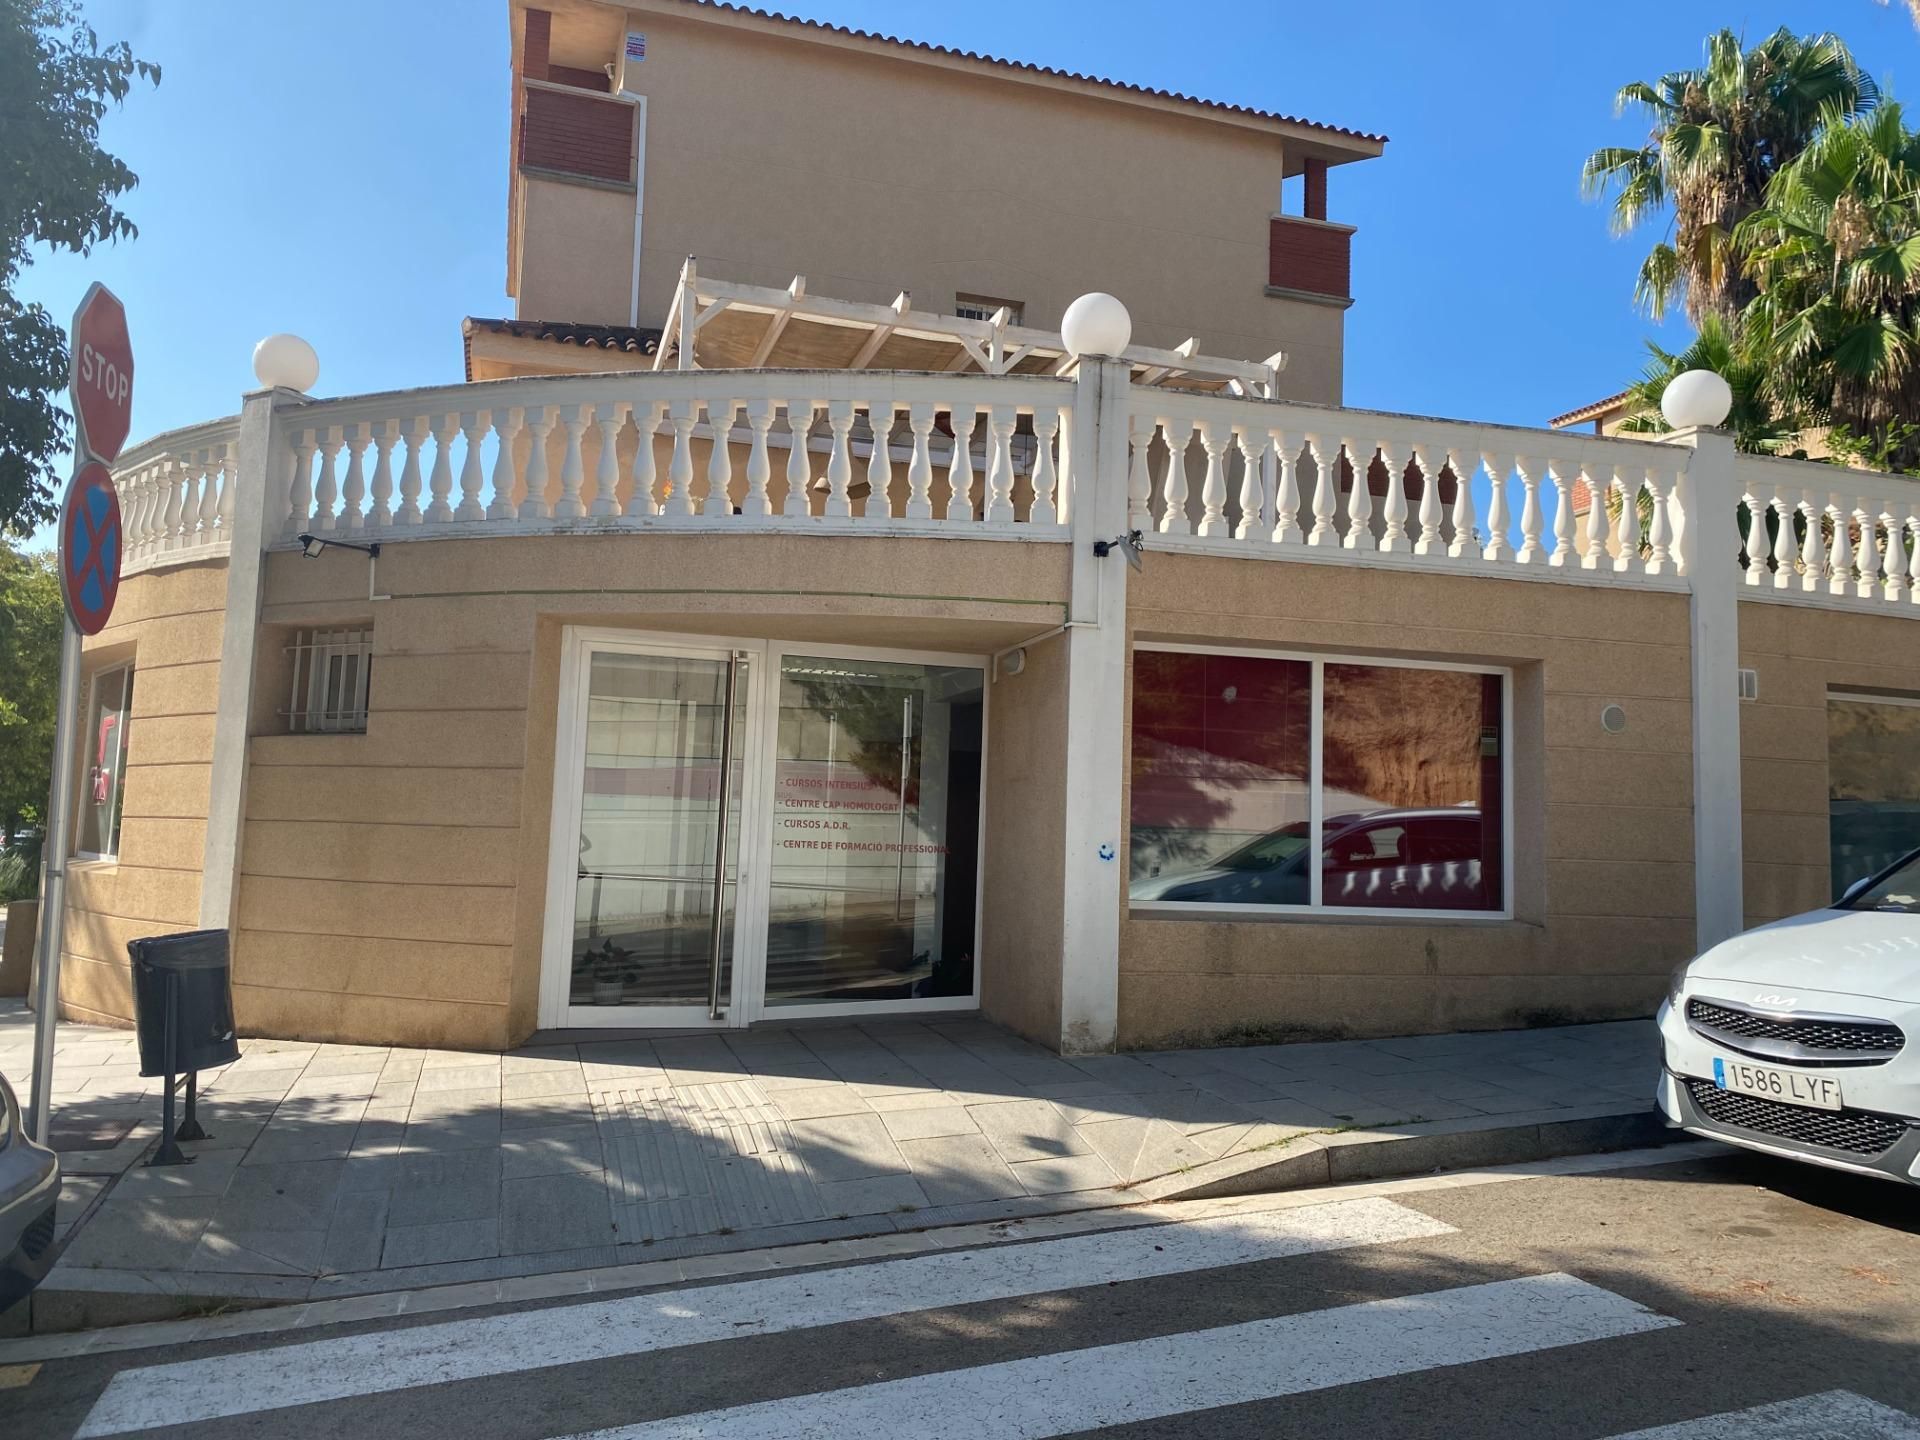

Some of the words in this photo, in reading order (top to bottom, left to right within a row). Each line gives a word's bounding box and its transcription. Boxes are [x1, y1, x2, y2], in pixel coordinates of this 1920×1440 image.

[82, 343, 128, 407] STOP
[785, 778, 822, 788] CURSOS
[784, 798, 820, 809] CENTRE
[822, 800, 841, 809] CAP
[843, 801, 898, 811] HOMOLOGAT
[784, 819, 821, 830] CURSOS
[823, 821, 851, 830] A.D.R.
[783, 840, 818, 849] CENTRE
[820, 841, 833, 850] DE
[885, 844, 951, 855] PROFESSIONAL
[1731, 1064, 1782, 1094] 1586
[1790, 1074, 1835, 1103] LYF
